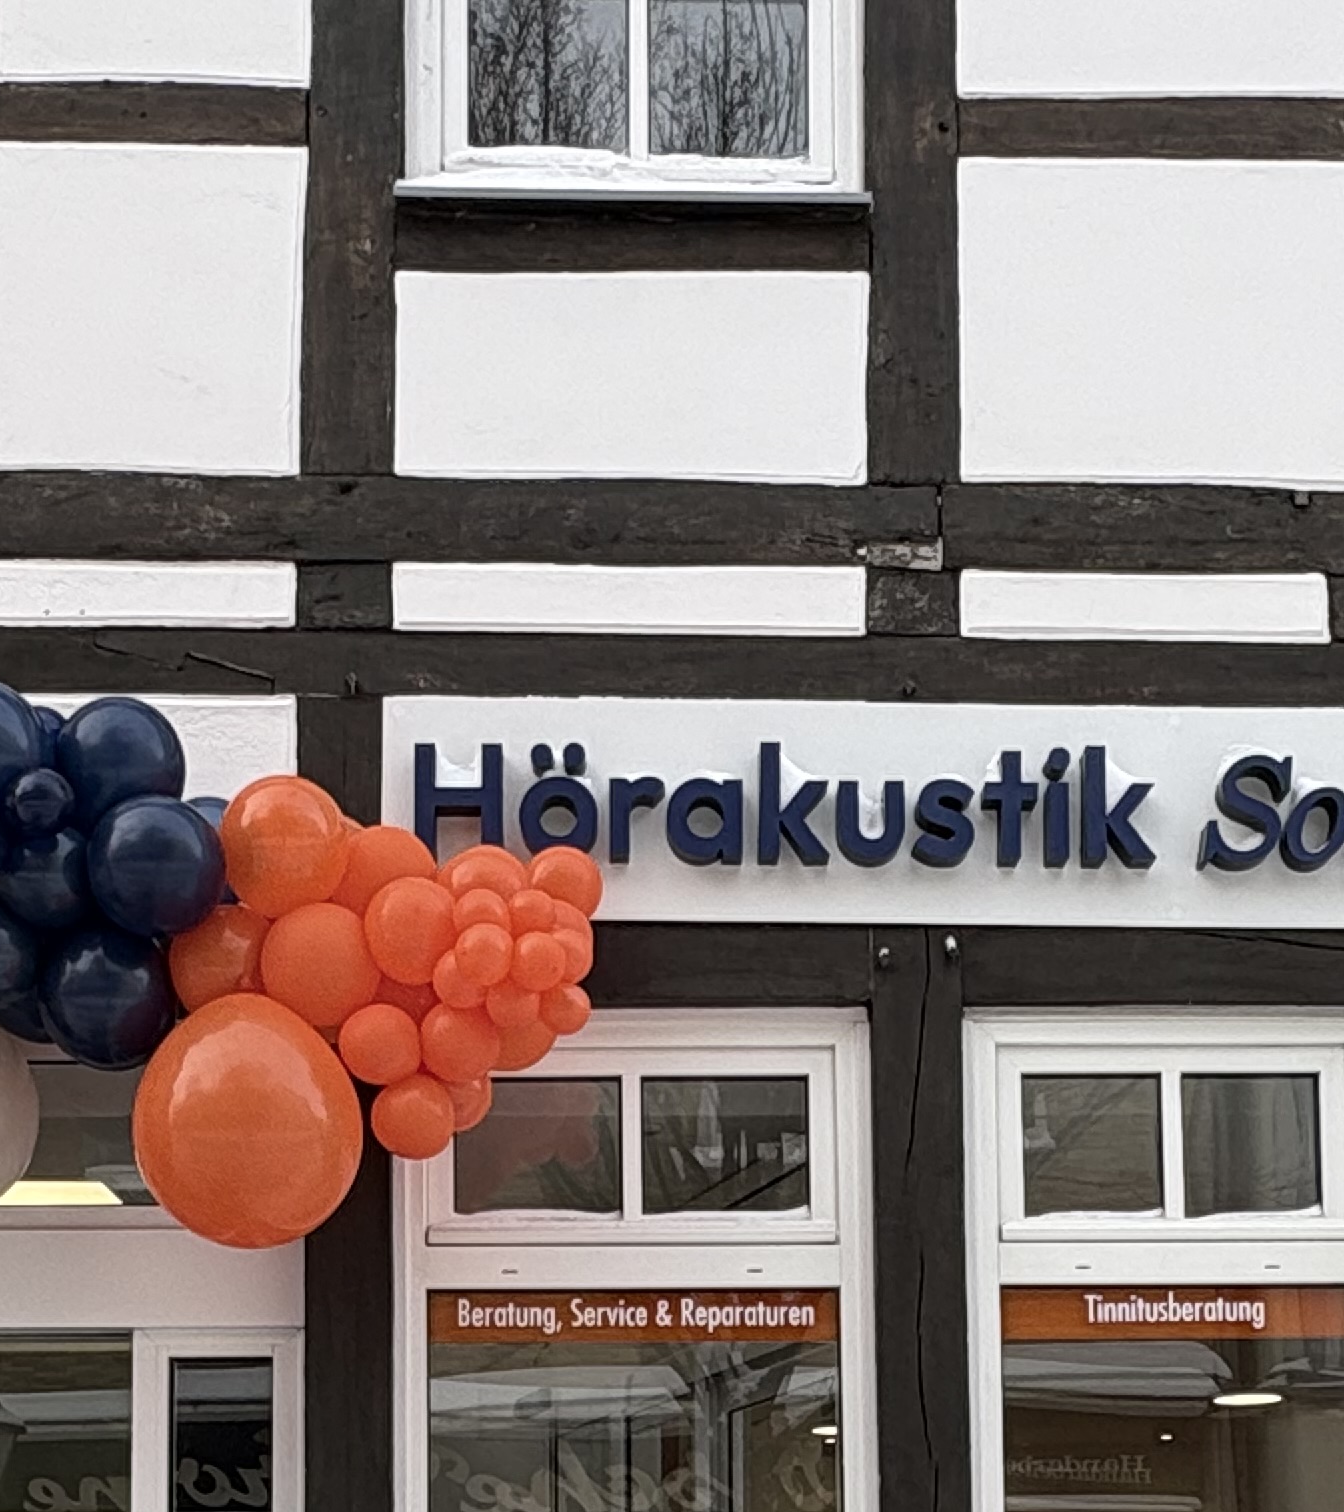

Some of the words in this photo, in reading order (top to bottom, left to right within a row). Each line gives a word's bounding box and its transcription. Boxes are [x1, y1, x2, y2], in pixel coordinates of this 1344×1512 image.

[413, 741, 1156, 869] Hörakustik
[457, 1298, 562, 1334] Beratung,
[570, 1299, 648, 1328] Service
[655, 1300, 673, 1328] &
[680, 1299, 815, 1332] Reparaturen
[1083, 1292, 1266, 1329] Tinnitusberatung
